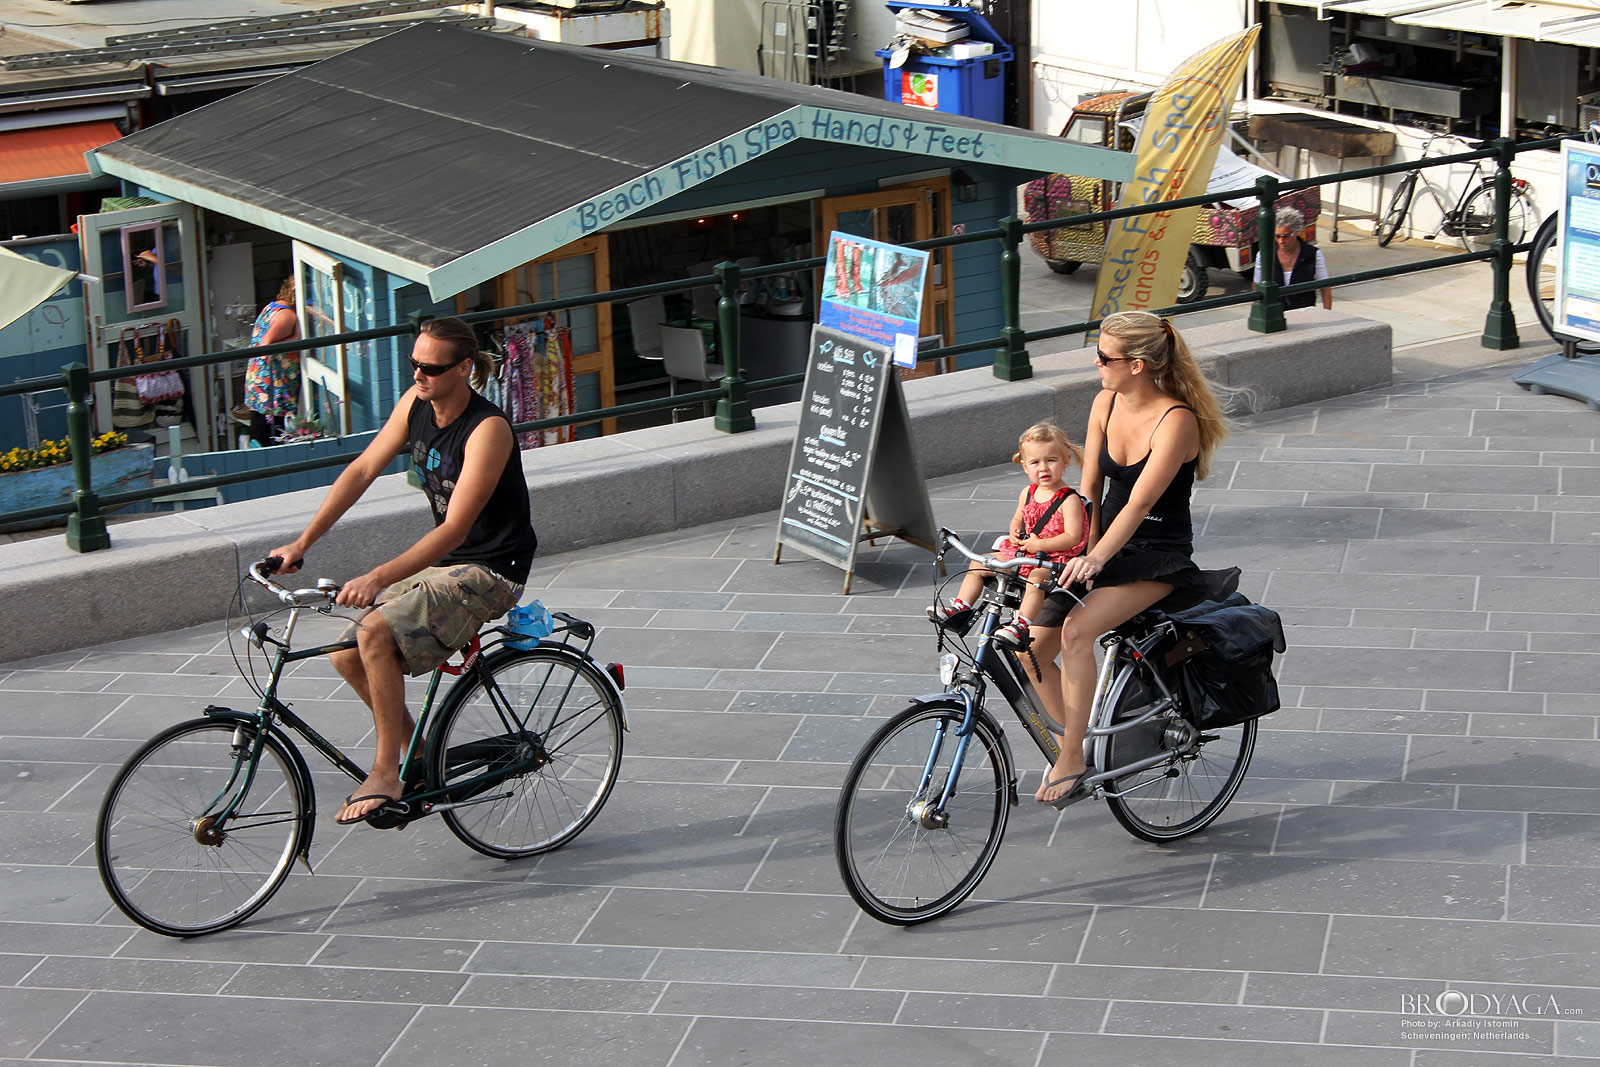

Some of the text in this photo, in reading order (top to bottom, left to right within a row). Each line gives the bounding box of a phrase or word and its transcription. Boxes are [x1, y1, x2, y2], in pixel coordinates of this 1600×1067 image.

[812, 109, 900, 148] Hands
[924, 126, 984, 158] Feet
[1121, 167, 1169, 234] Fsh
[1152, 94, 1194, 153] Spa
[576, 119, 797, 233] Beach Fish Spa
[1148, 226, 1168, 241] &
